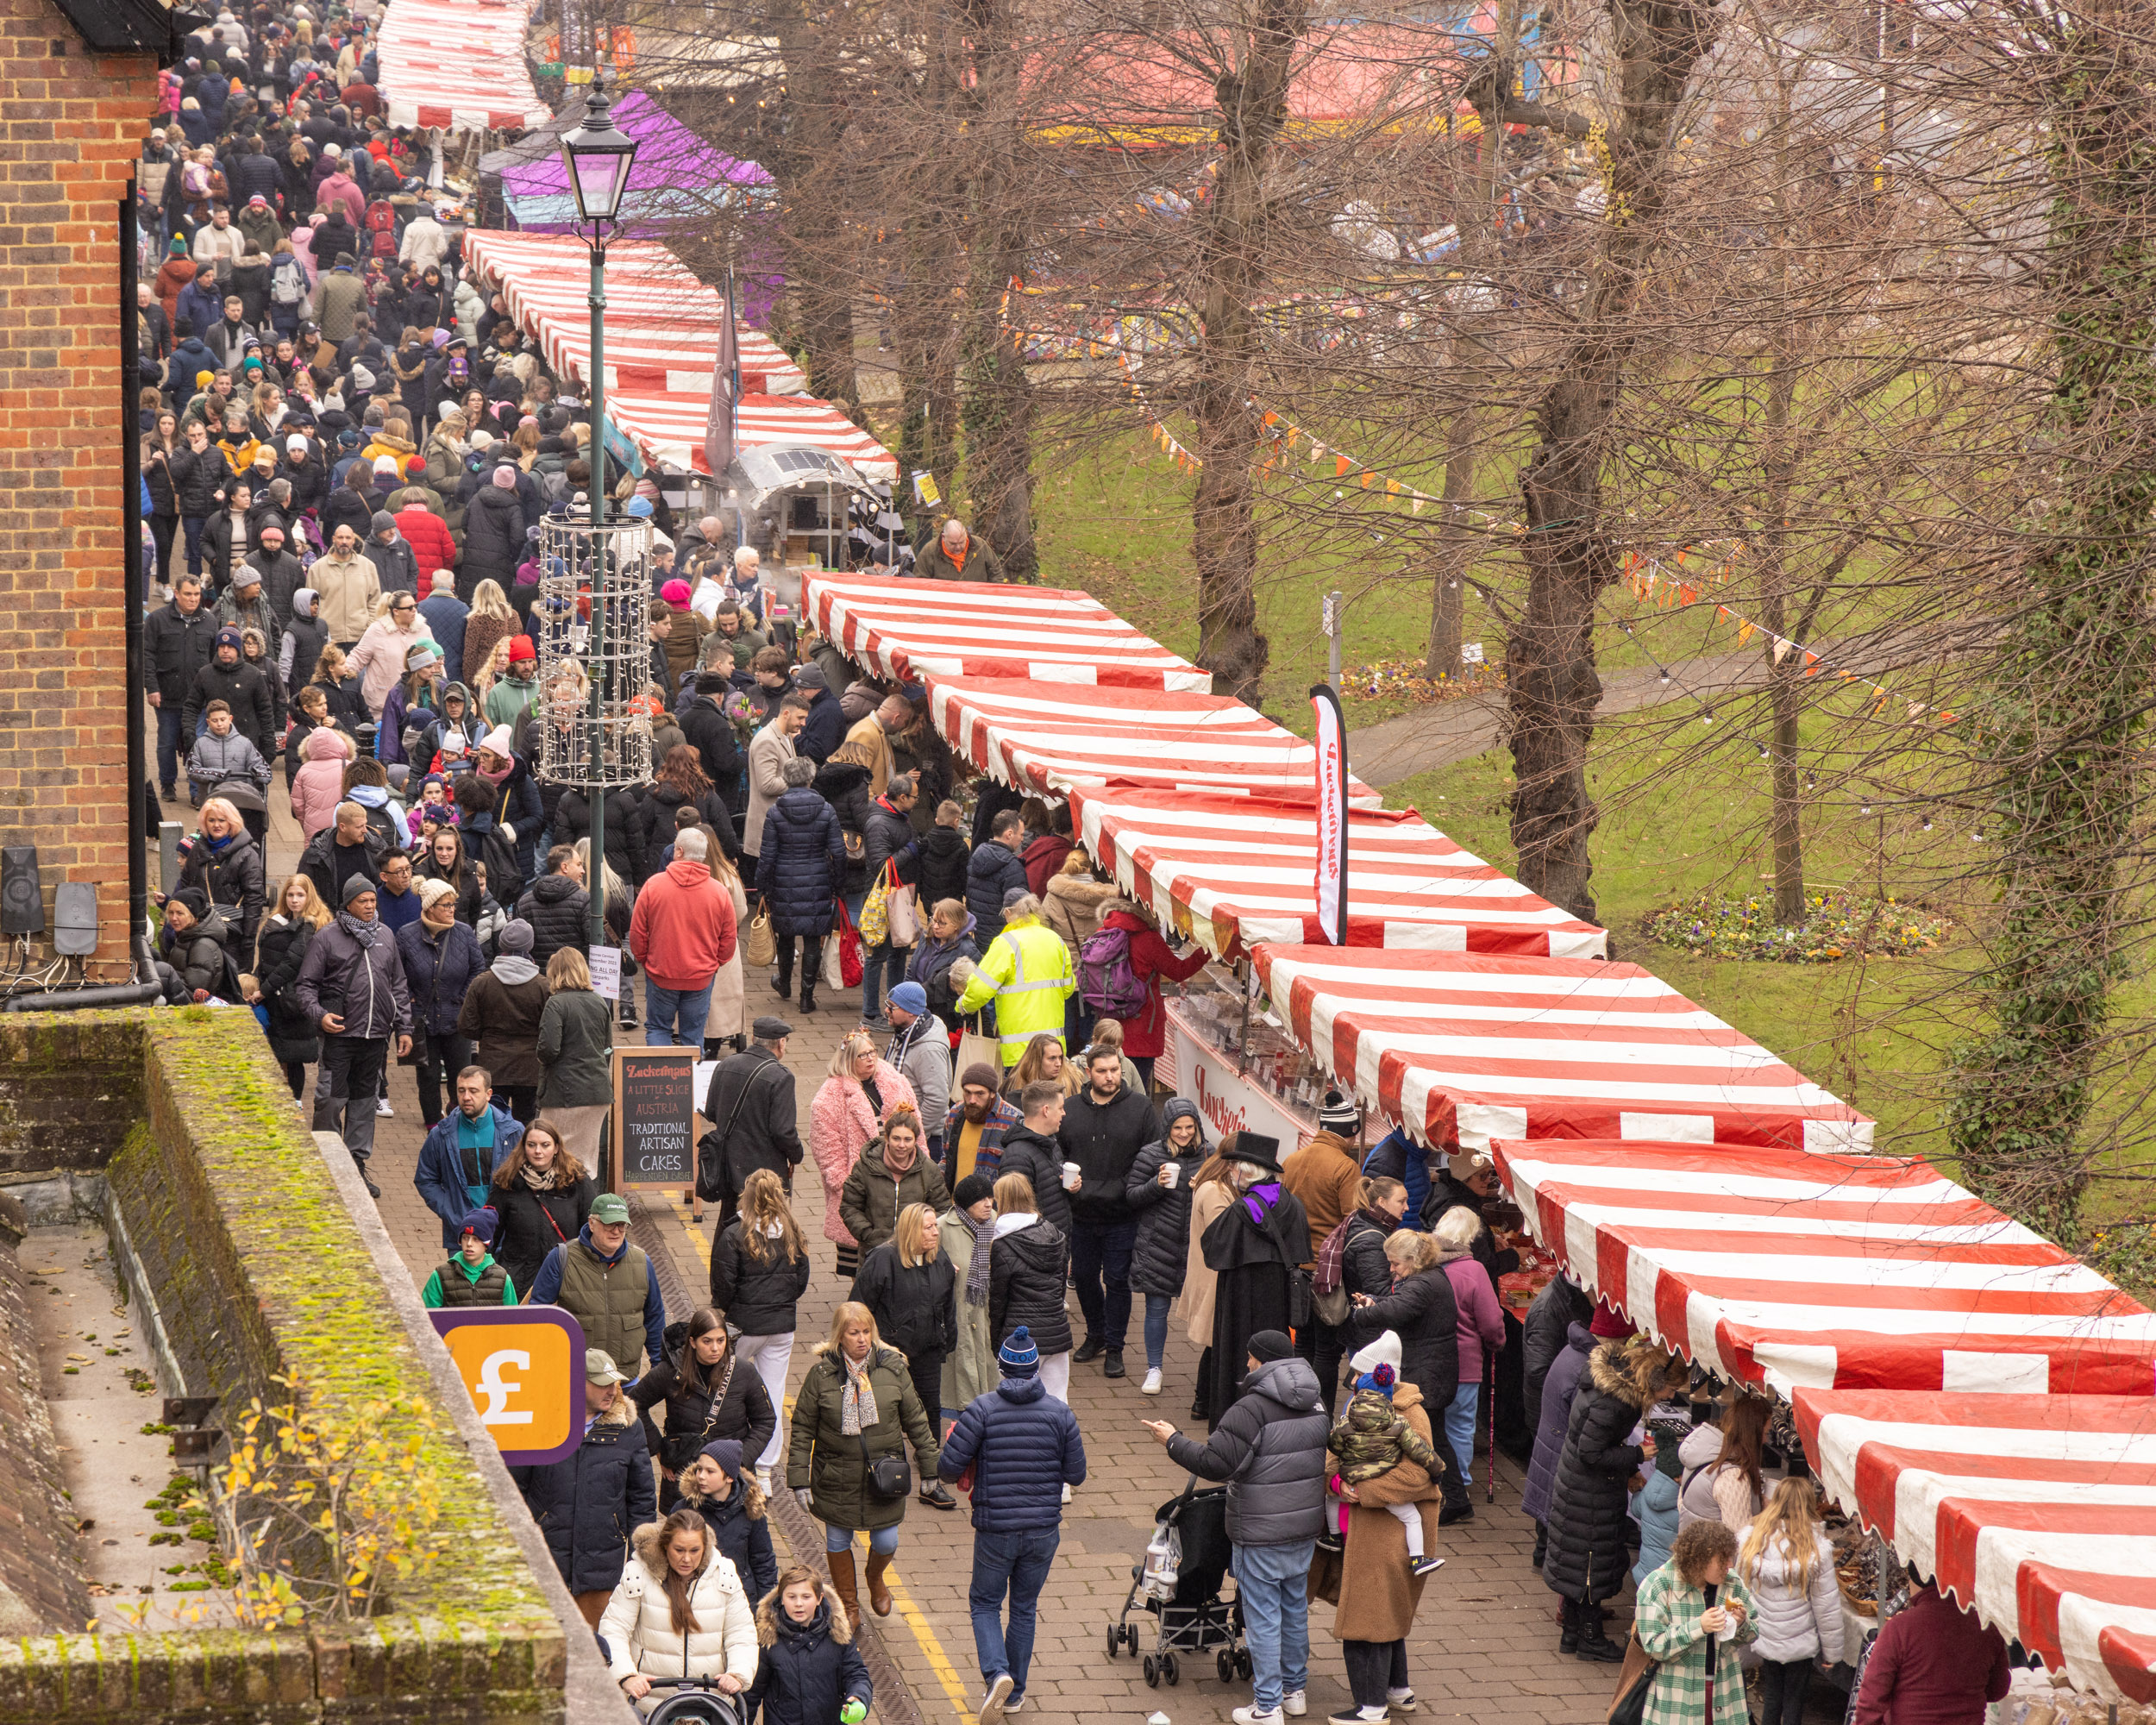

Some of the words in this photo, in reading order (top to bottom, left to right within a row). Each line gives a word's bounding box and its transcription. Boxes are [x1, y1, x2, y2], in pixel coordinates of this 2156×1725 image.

[628, 1085, 633, 1095] A
[635, 1085, 664, 1095] LITTLE
[665, 1084, 690, 1095] SLICE
[636, 1103, 679, 1116] AUSTRIA
[630, 1122, 690, 1135] TRADITIONAL
[639, 1137, 684, 1151] ARTISAN
[640, 1155, 681, 1171] CAKES
[476, 1349, 534, 1425] £
